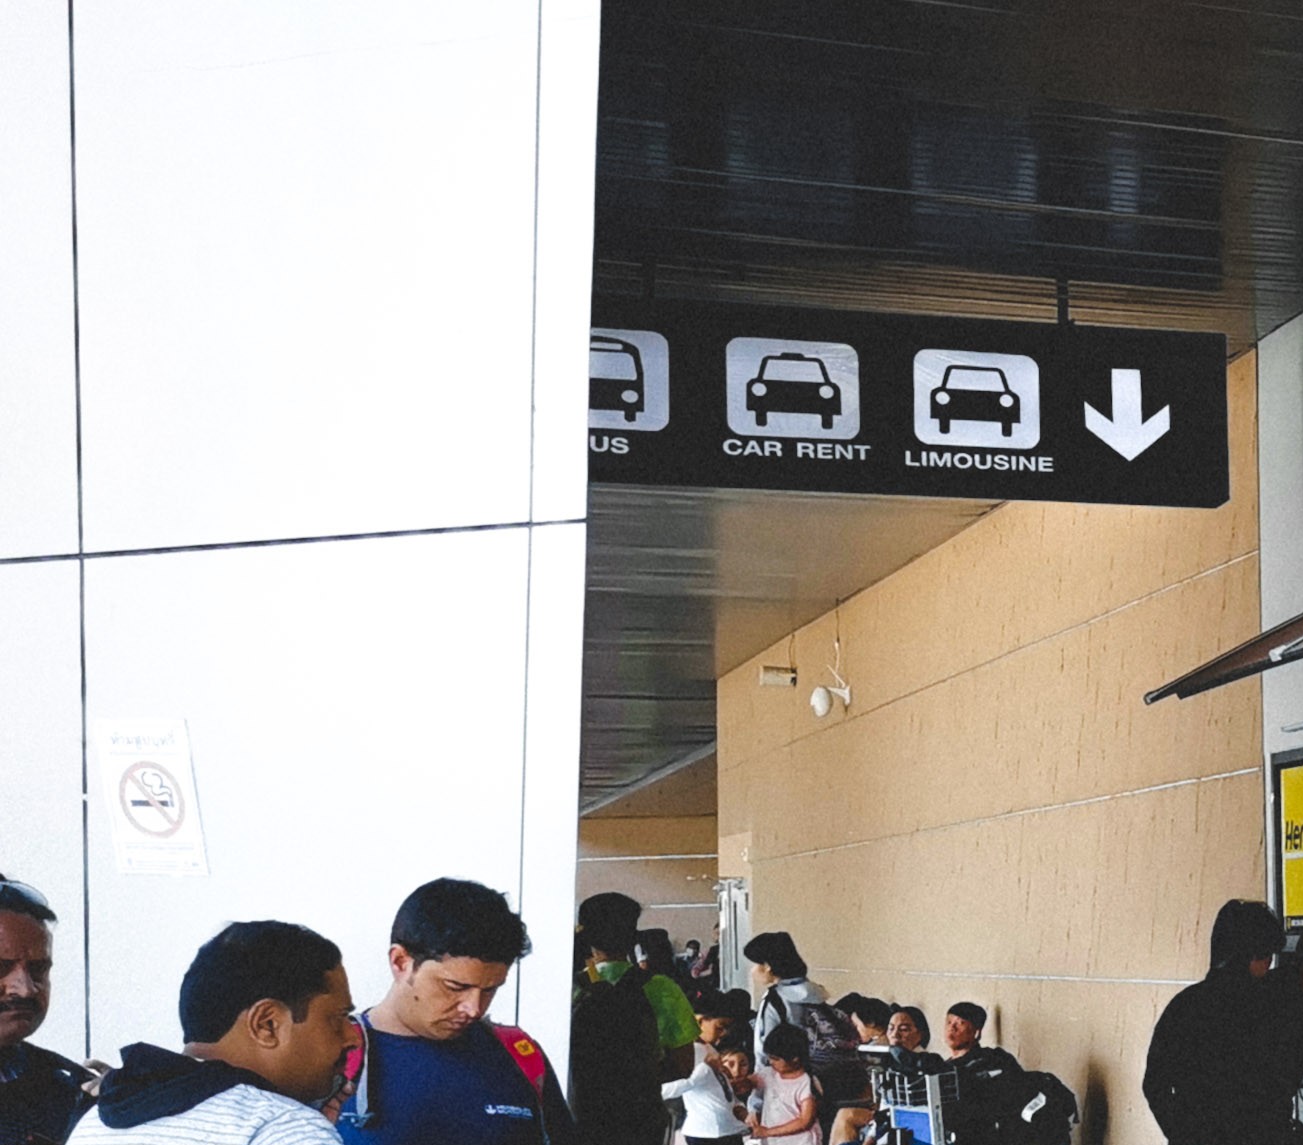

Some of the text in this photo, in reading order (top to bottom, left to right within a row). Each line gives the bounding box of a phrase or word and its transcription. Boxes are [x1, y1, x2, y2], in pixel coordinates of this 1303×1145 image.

[589, 436, 631, 455] US
[722, 438, 870, 462] CAR RENT
[904, 450, 1054, 474] LIMOUSINE
